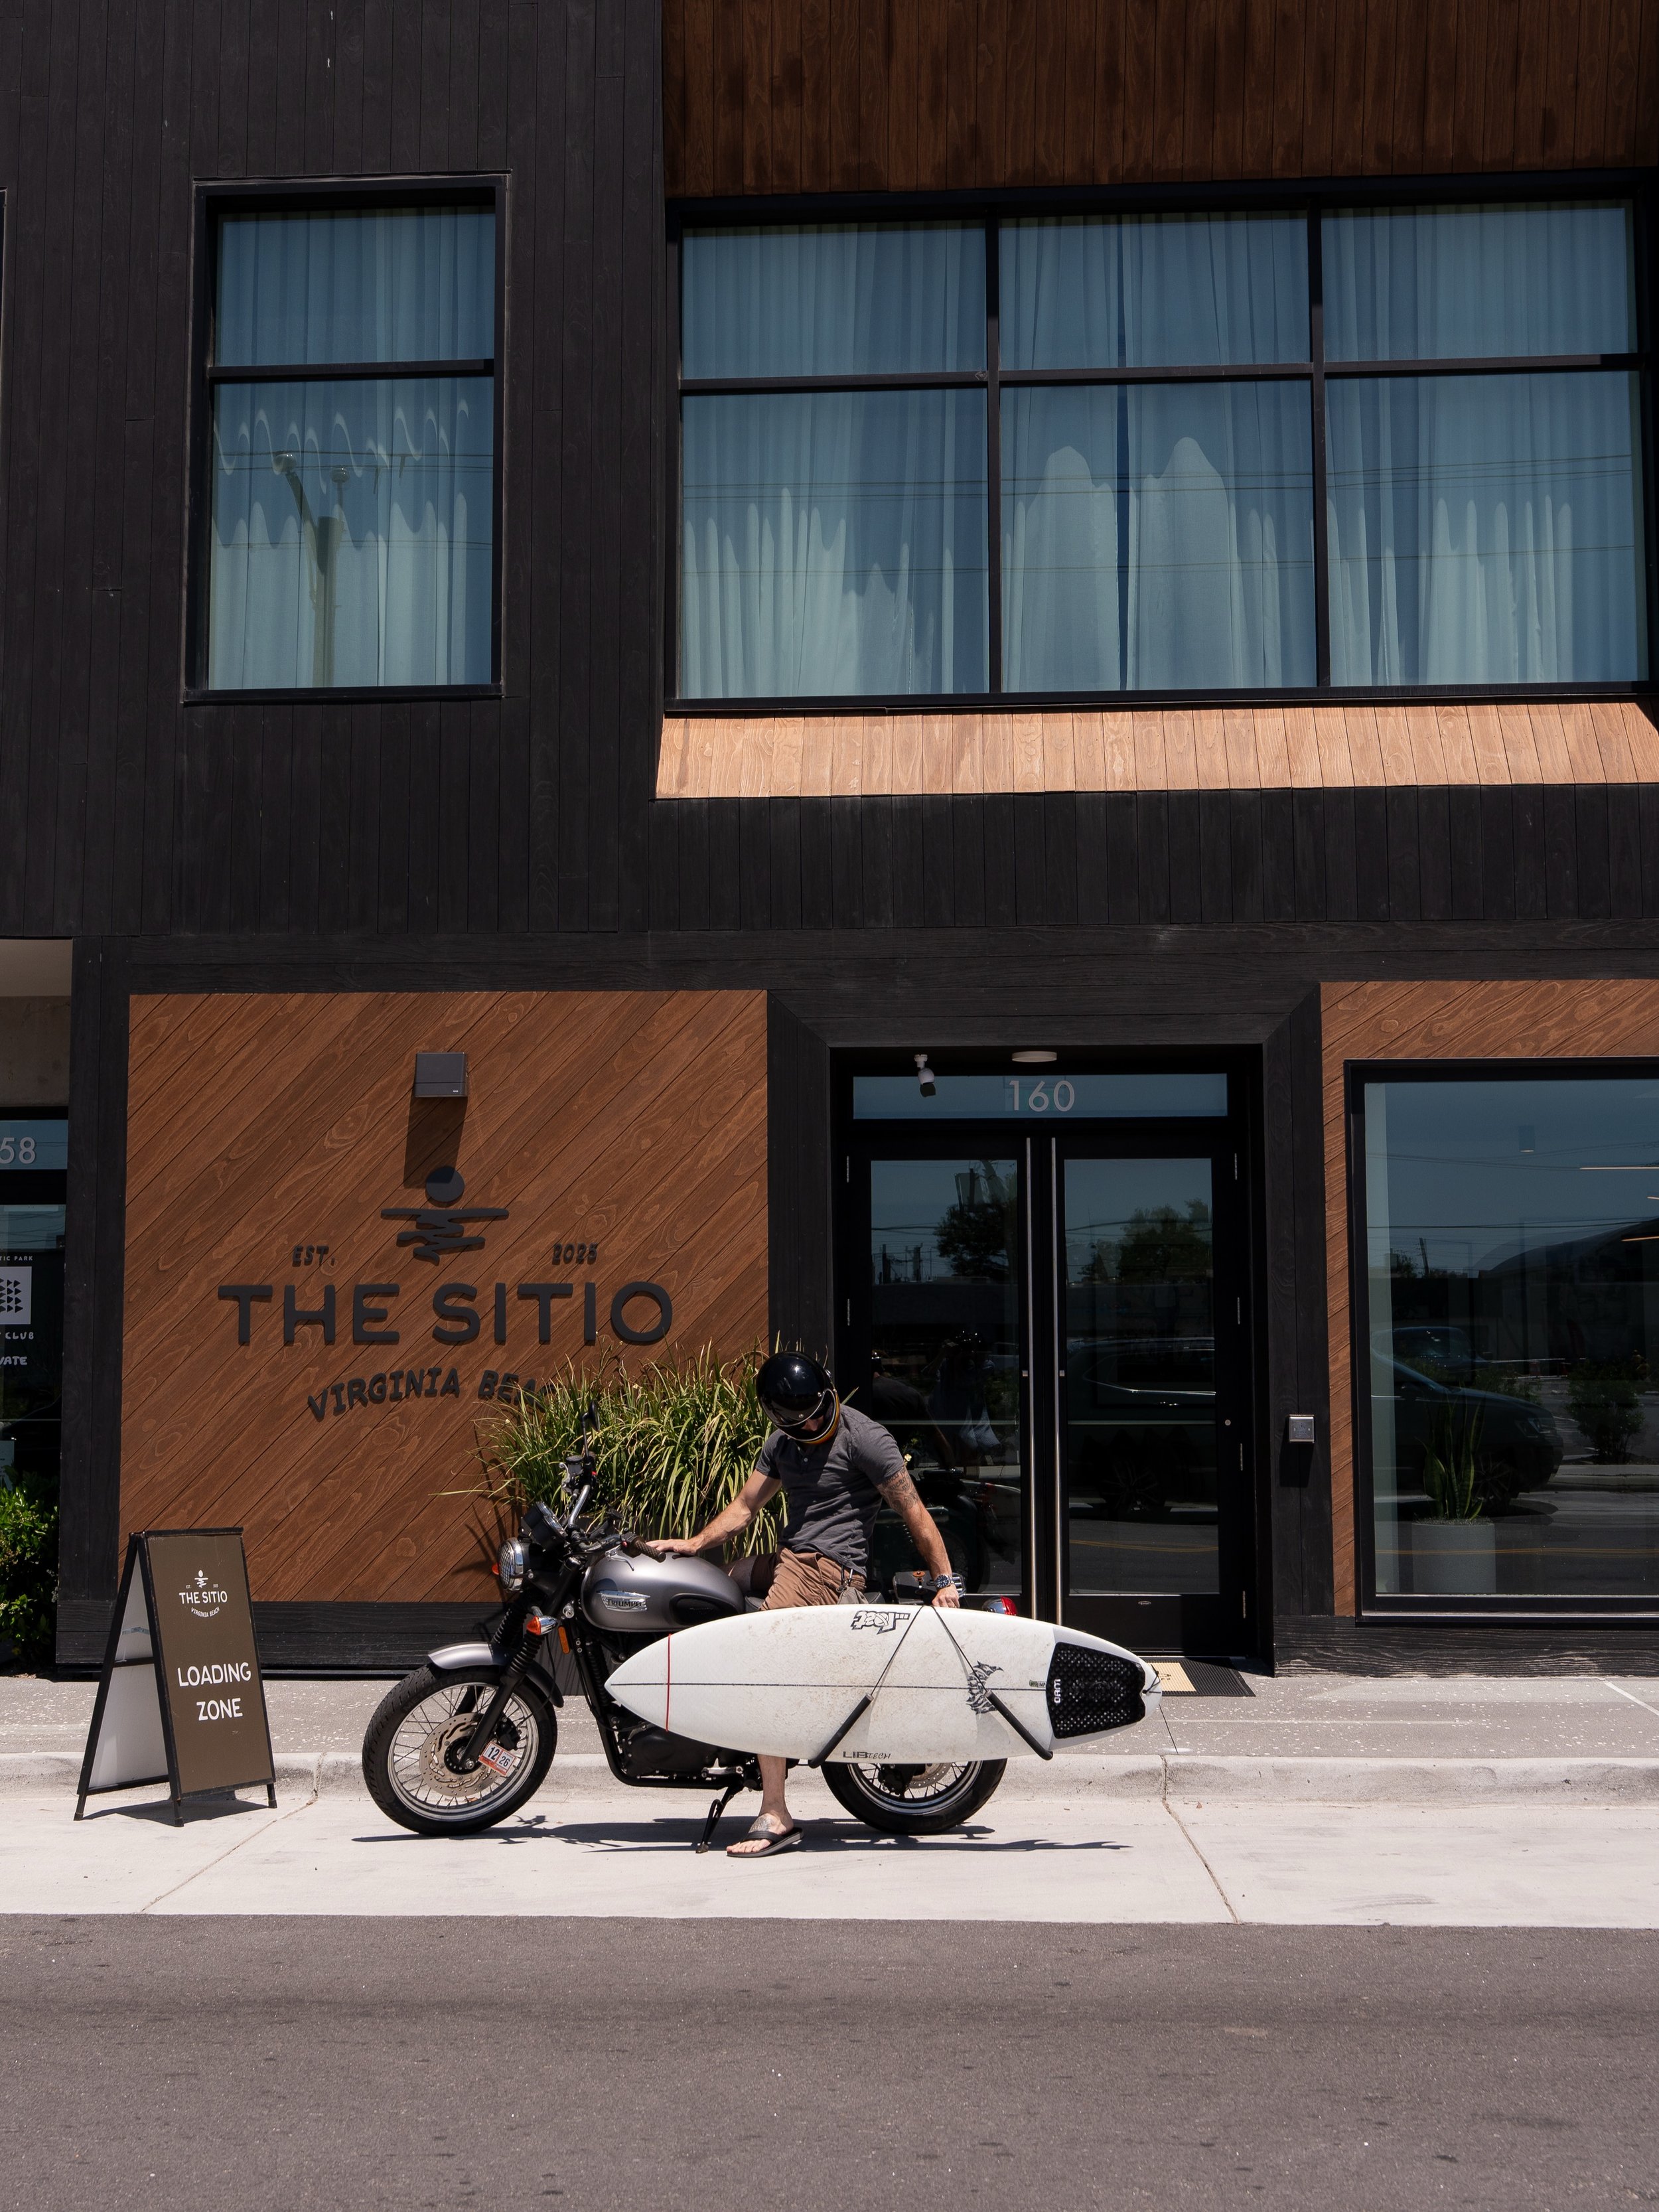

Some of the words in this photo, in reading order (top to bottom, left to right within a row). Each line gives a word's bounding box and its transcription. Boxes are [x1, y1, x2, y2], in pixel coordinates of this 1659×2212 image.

[1009, 1080, 1075, 1112] 160
[0, 1136, 36, 1164] 58
[292, 1245, 335, 1267] EST.
[551, 1242, 598, 1266] 2025
[218, 1283, 400, 1346] THE
[432, 1281, 674, 1346] SITIO
[5, 1331, 35, 1340] CLUB
[307, 1367, 460, 1422] VIRGINIA
[478, 1370, 559, 1412] BEA
[179, 1591, 200, 1604] THE
[202, 1590, 228, 1603] SITIO
[606, 1599, 642, 1607] TRIUMPH
[191, 1607, 209, 1617] VIRGINIA
[209, 1606, 220, 1617] BEACH
[177, 1662, 252, 1687] LOADING
[196, 1698, 243, 1721] ZONE
[487, 1746, 500, 1760] 12
[499, 1755, 510, 1767] 26
